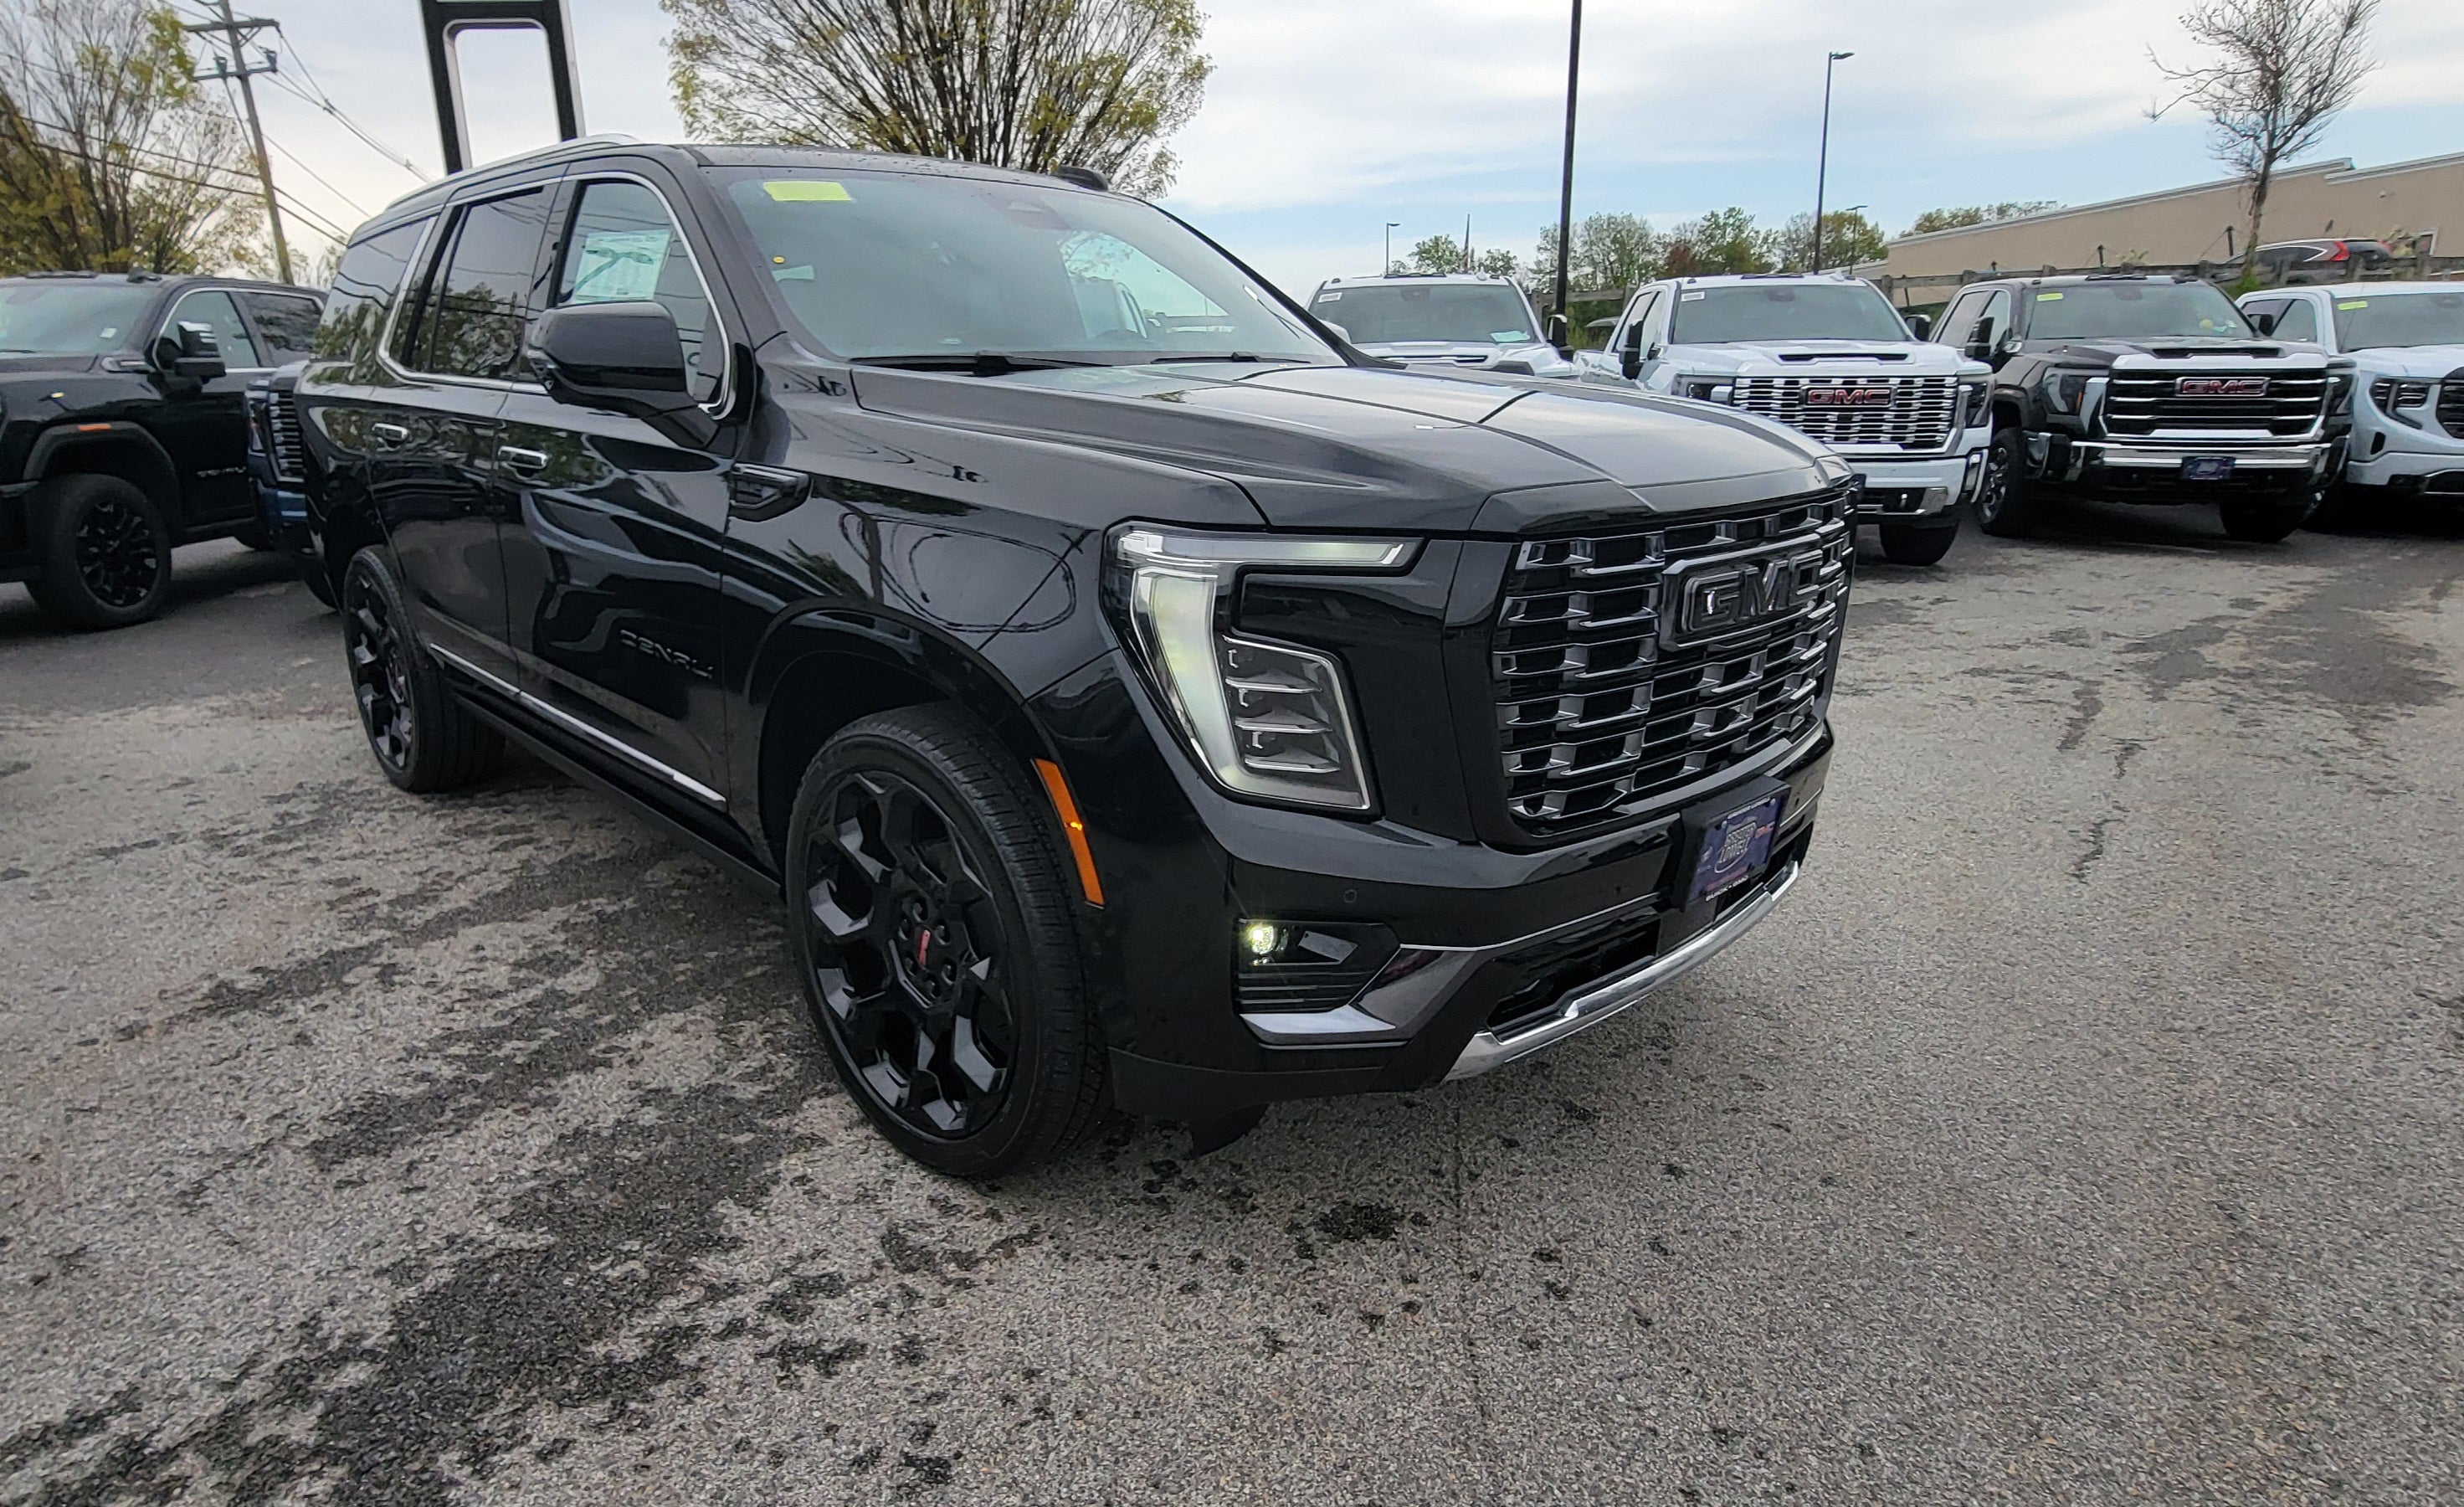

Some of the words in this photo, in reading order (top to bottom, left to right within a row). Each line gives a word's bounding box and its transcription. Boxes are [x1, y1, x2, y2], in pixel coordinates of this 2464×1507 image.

[2182, 380, 2265, 393] GMC
[1808, 388, 1891, 404] GMC
[1682, 549, 1823, 631] GMC
